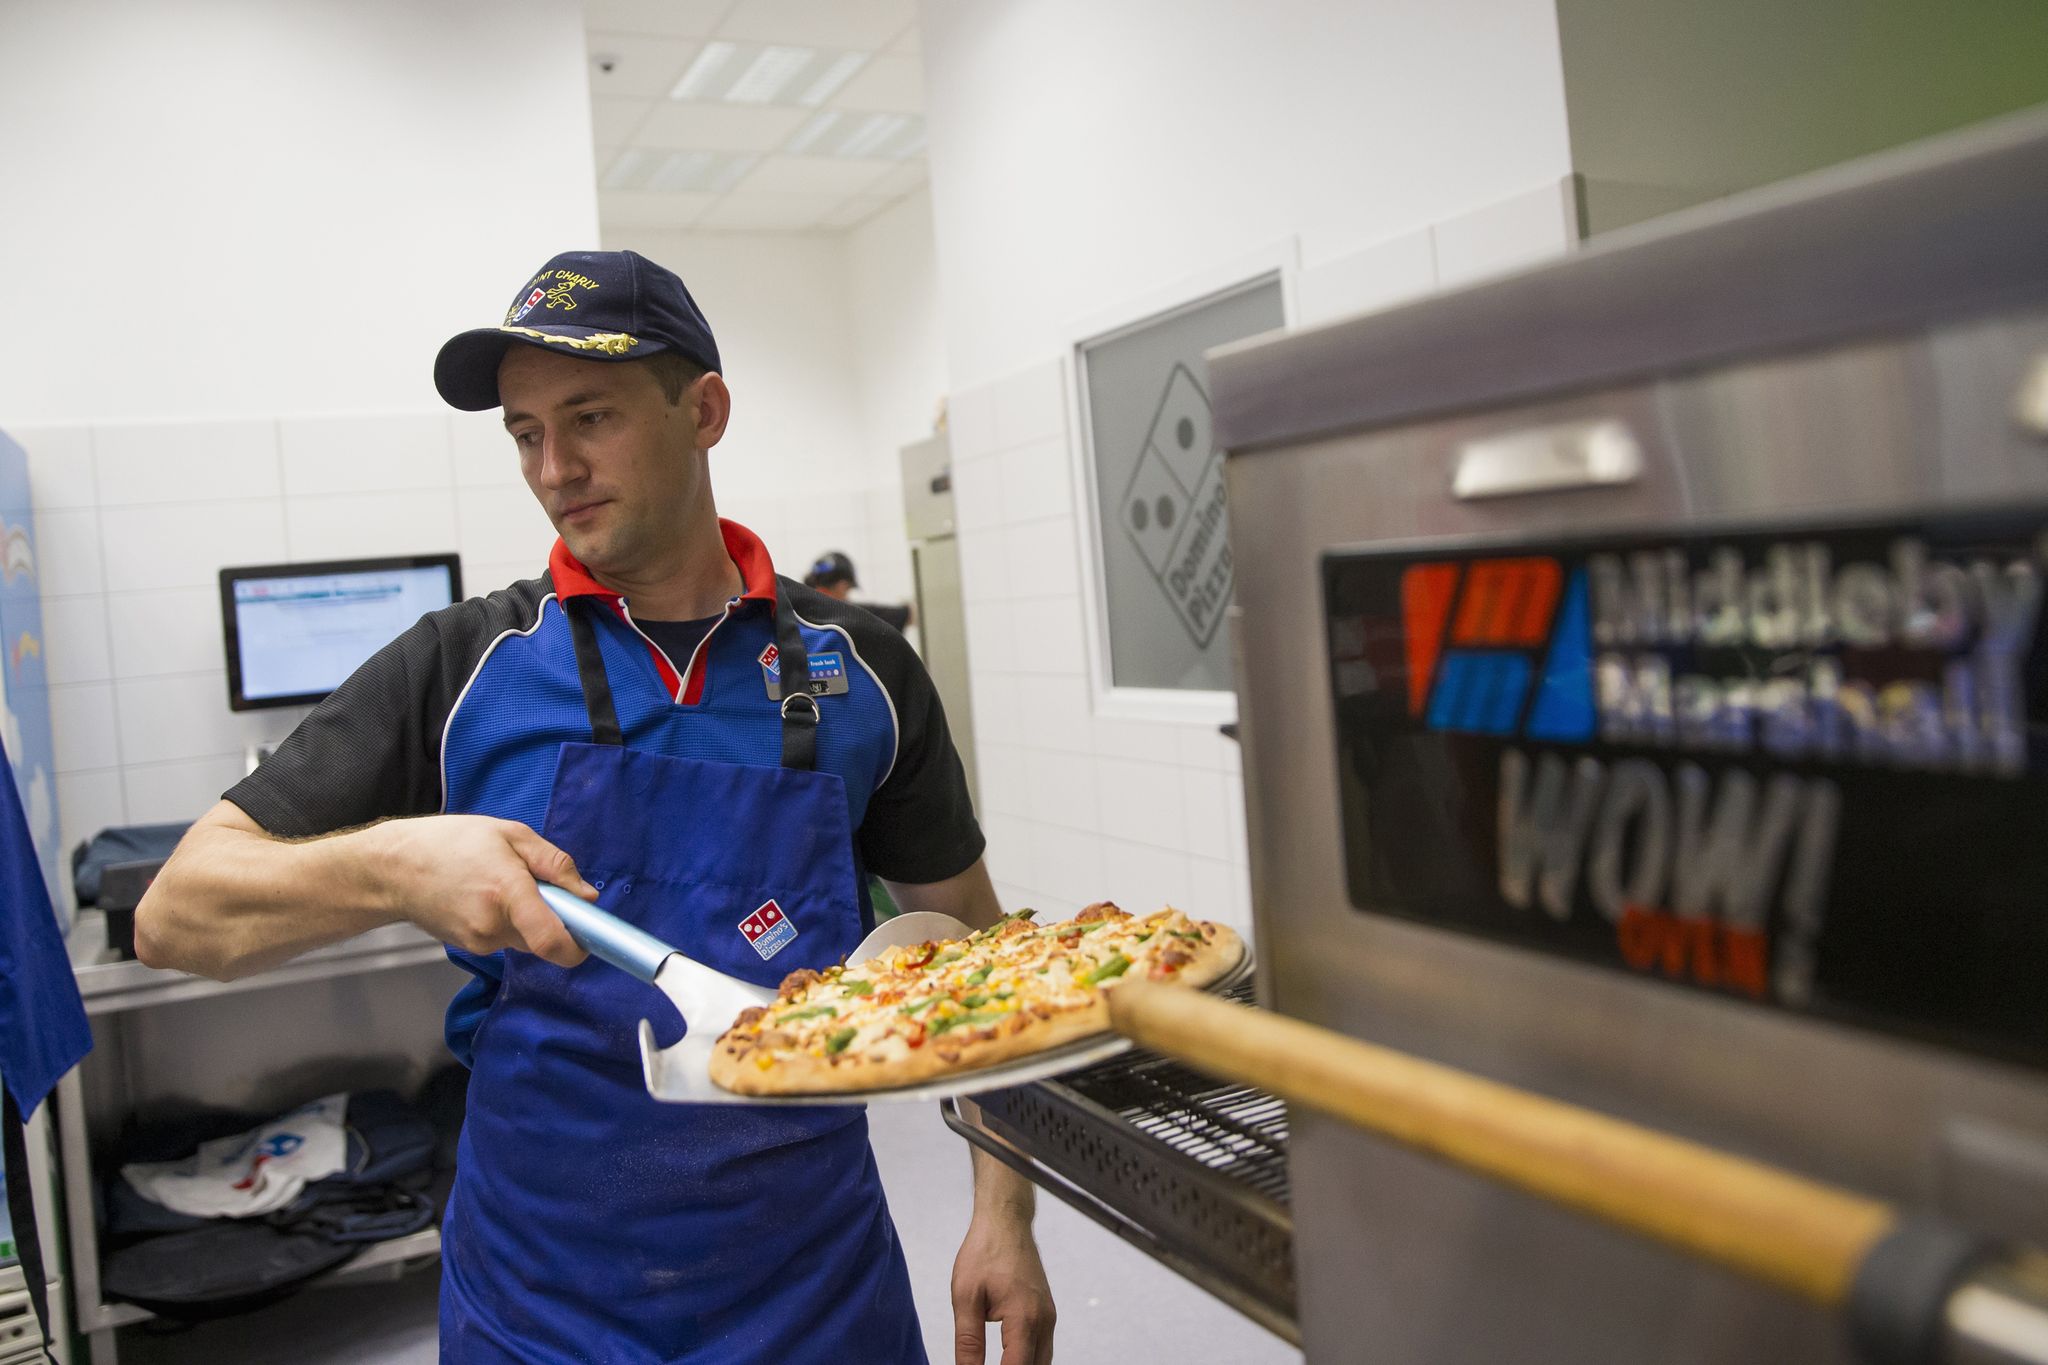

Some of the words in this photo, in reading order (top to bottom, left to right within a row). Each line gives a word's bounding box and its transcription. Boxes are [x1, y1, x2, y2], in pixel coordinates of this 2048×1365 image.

[555, 269, 600, 290] CHARLY
[1170, 481, 1227, 600] Domino
[1590, 541, 2043, 776] Middleby
[754, 922, 789, 950] Domino's
[1499, 751, 1840, 1004] WOW!
